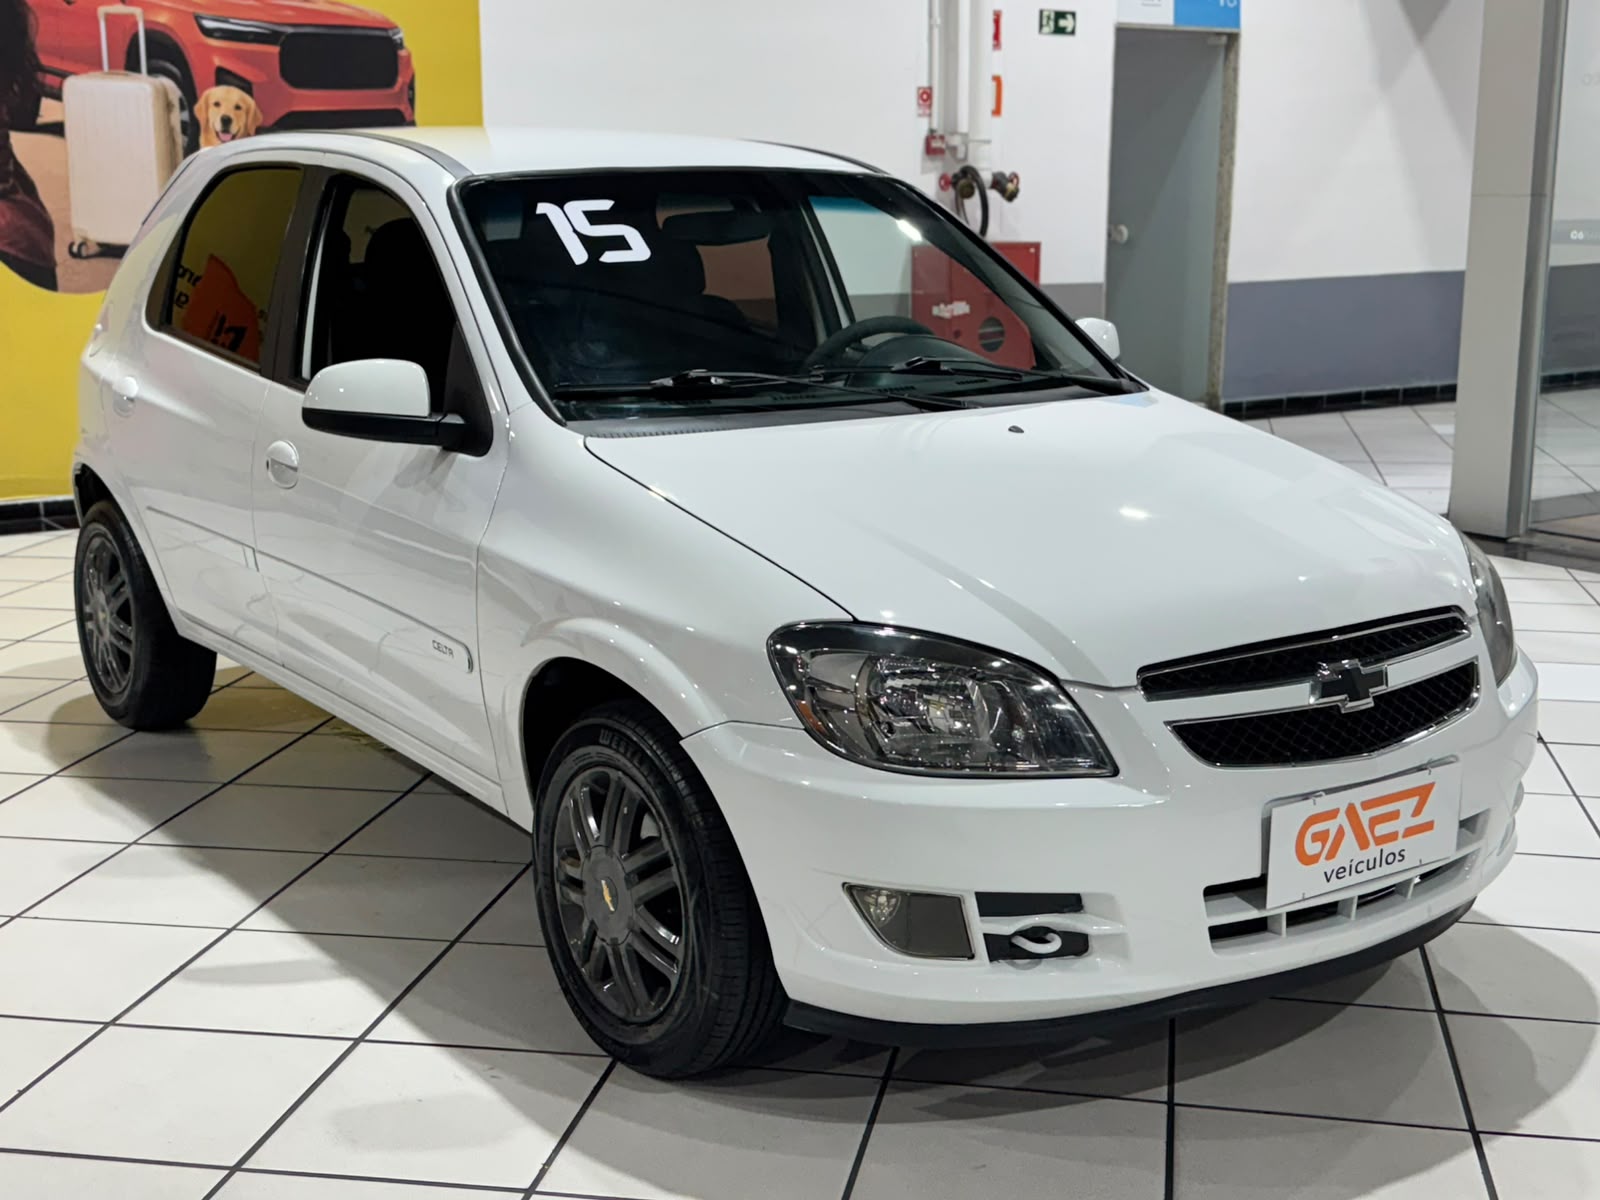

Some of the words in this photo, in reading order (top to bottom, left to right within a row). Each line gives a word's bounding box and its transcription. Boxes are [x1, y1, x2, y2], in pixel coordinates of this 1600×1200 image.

[535, 199, 651, 266] 15
[1295, 782, 1436, 866] GAEZ
[1323, 848, 1406, 883] veículos
